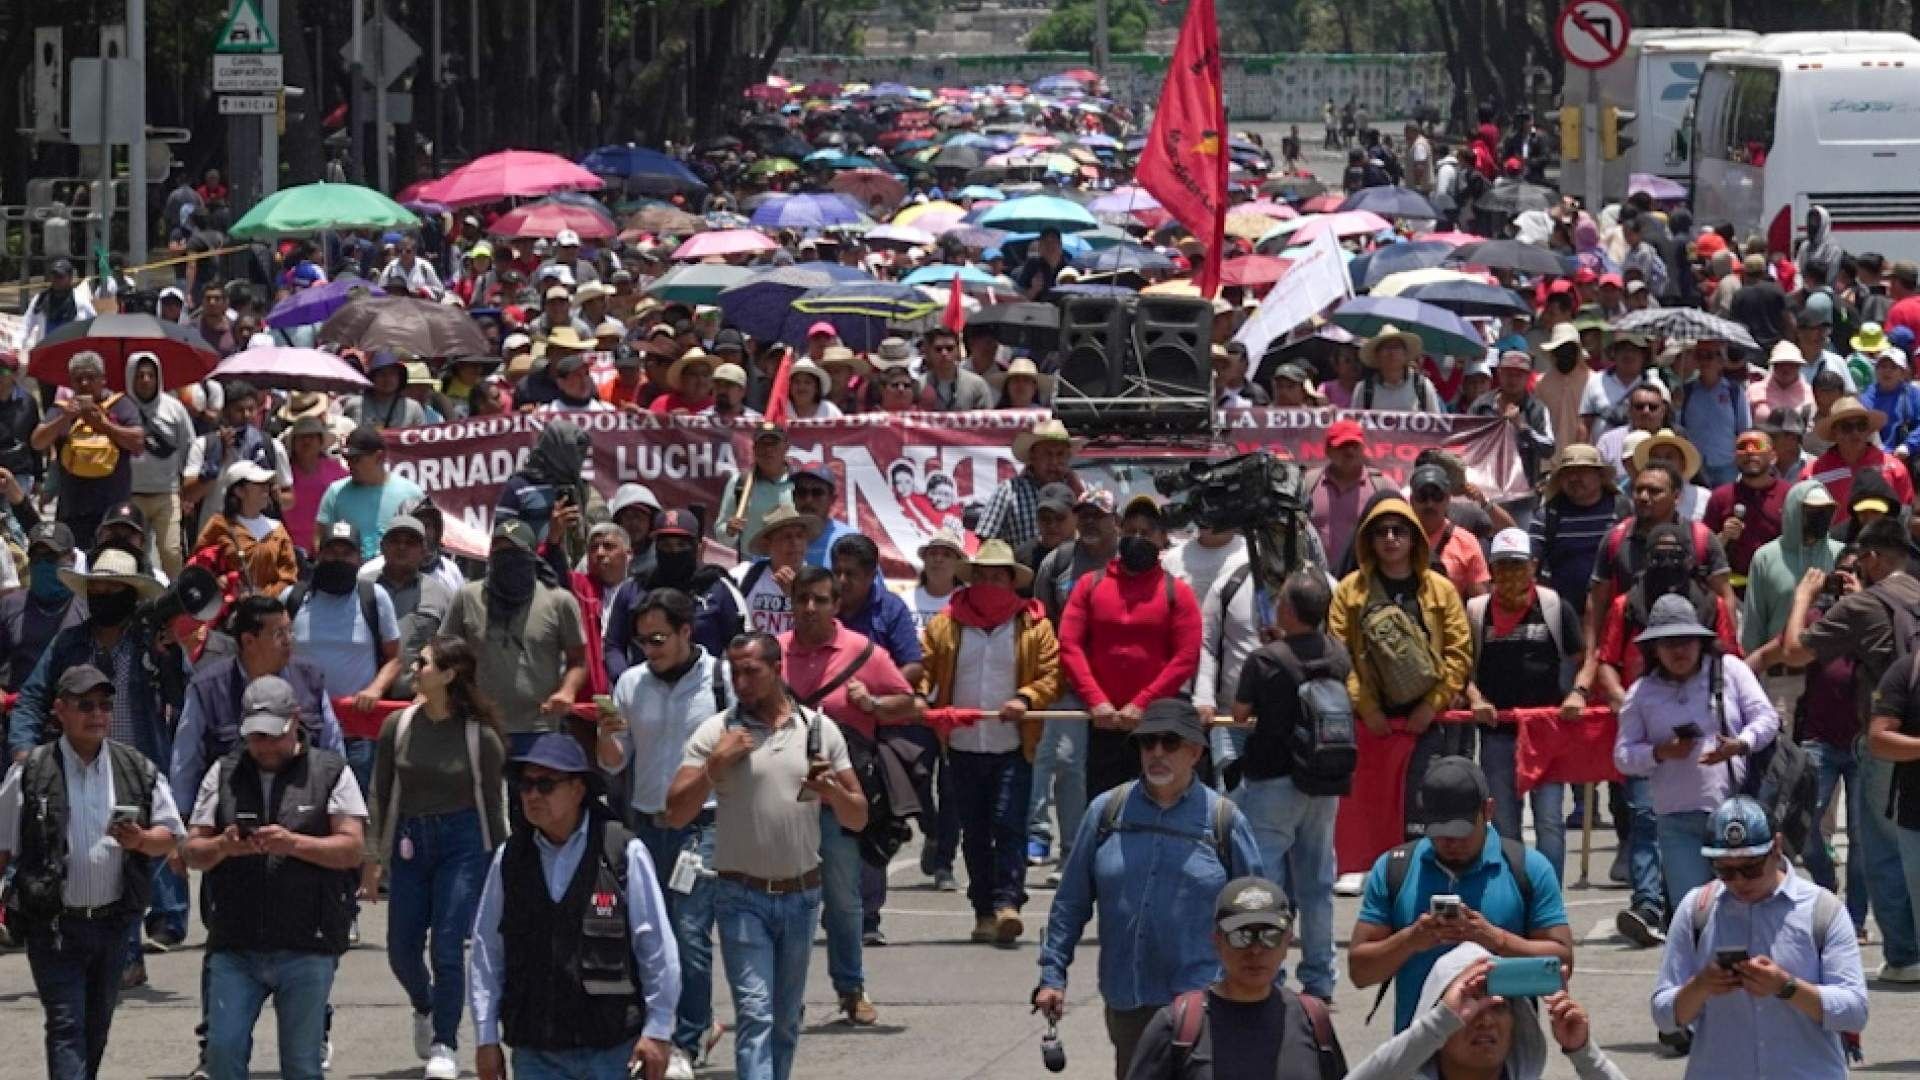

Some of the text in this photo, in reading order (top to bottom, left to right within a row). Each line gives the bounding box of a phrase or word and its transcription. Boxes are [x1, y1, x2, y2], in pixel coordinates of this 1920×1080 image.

[219, 67, 279, 76] COMPARTIDO
[400, 413, 662, 445] COORDINDORA
[384, 446, 532, 492] ORNADA
[616, 442, 741, 481] LUCHA
